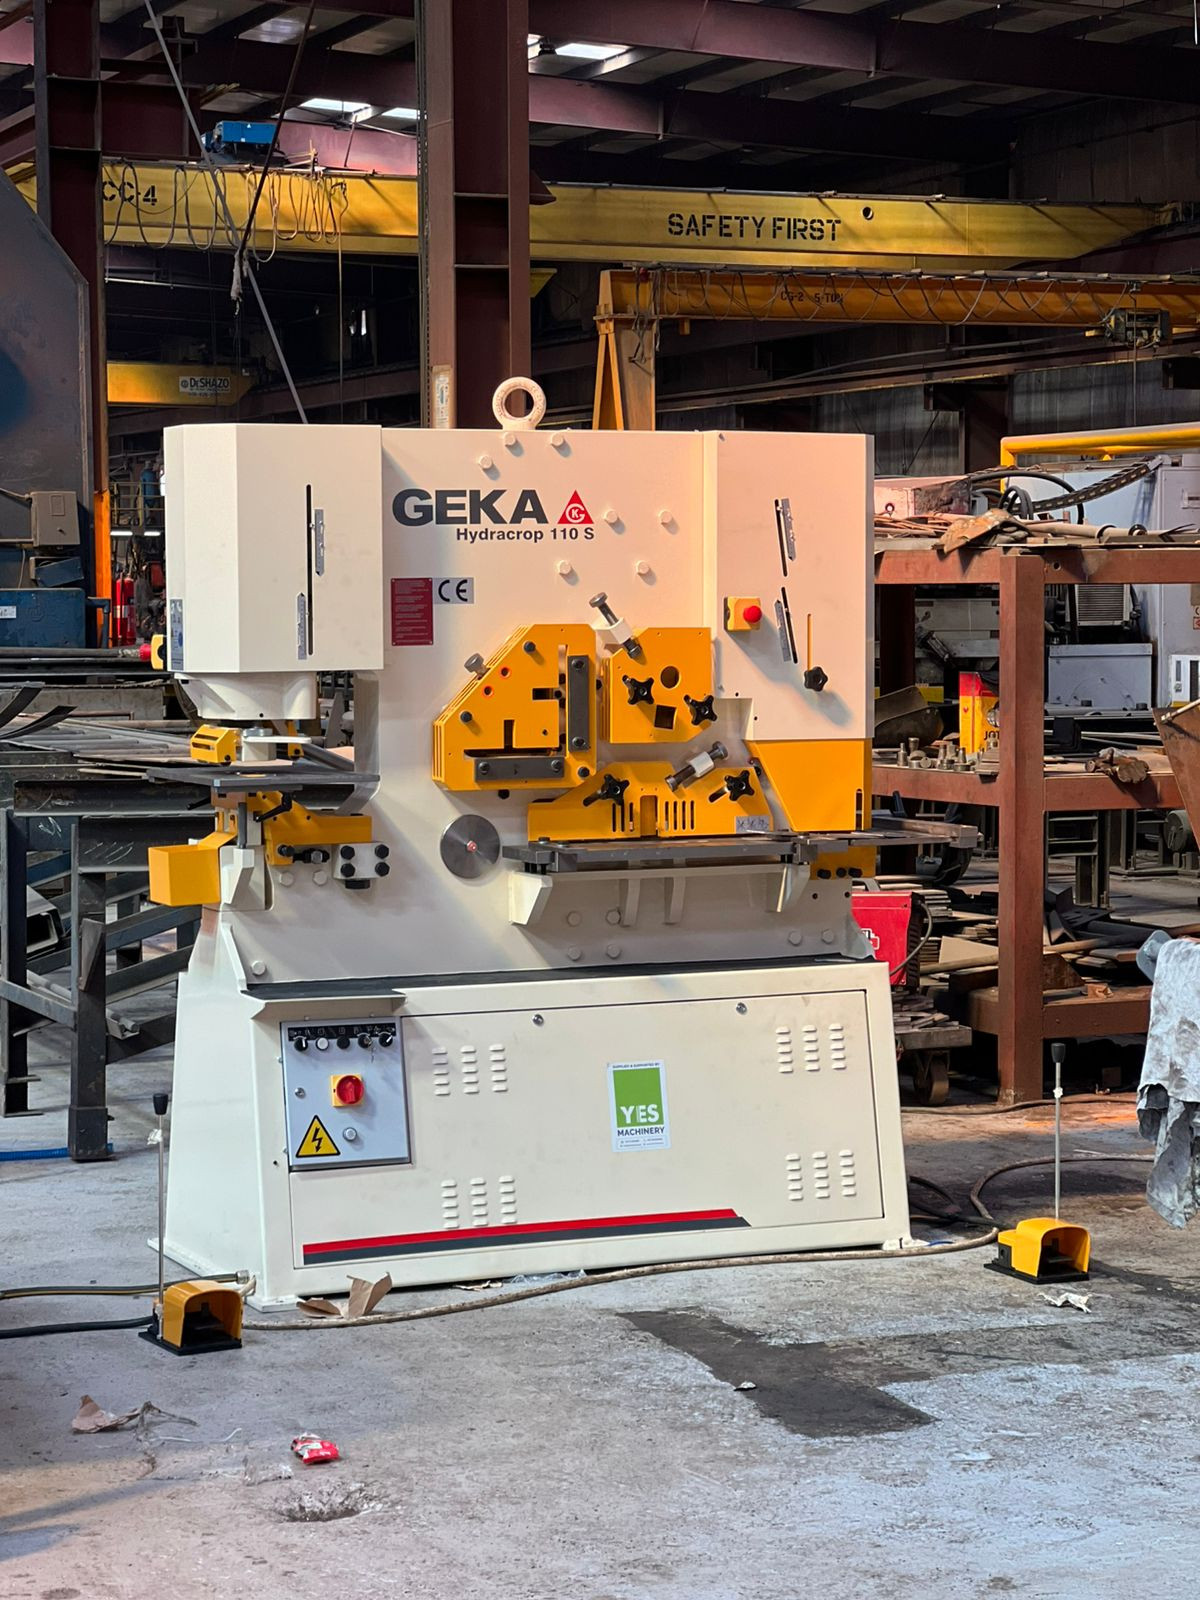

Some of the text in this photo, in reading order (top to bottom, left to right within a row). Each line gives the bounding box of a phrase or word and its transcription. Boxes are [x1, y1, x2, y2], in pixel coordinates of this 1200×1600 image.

[668, 213, 842, 242] SAFETY FIRST
[392, 488, 549, 527] GEKA
[456, 527, 595, 544] Hydracrop 110 S
[438, 579, 468, 602] CE
[620, 1104, 660, 1124] YES
[617, 1126, 665, 1137] MACHINERY
